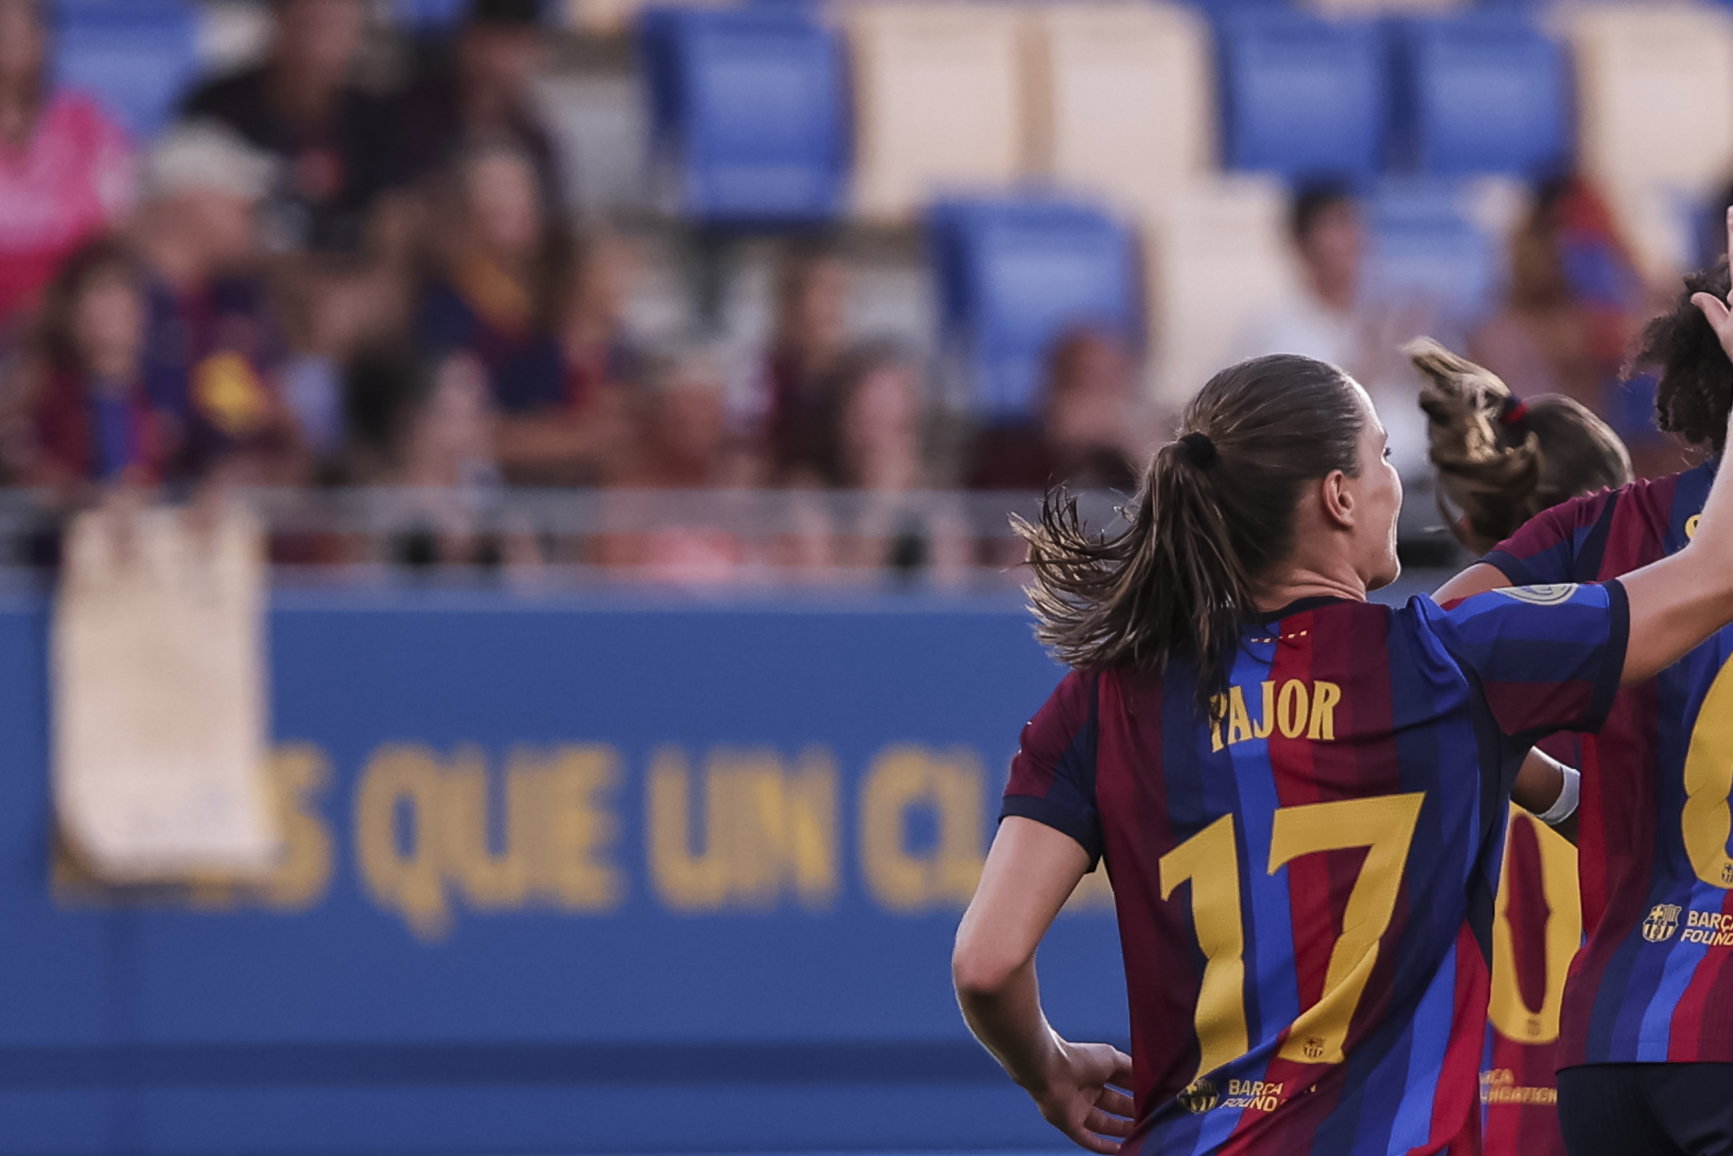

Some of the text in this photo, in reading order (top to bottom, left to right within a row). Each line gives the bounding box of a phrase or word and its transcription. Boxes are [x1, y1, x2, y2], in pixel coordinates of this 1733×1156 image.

[1209, 679, 1341, 753] PAJOR
[356, 742, 618, 945] QUE
[646, 744, 838, 914] UN
[1159, 792, 1426, 1078] 17
[1219, 1095, 1287, 1112] FOUND
